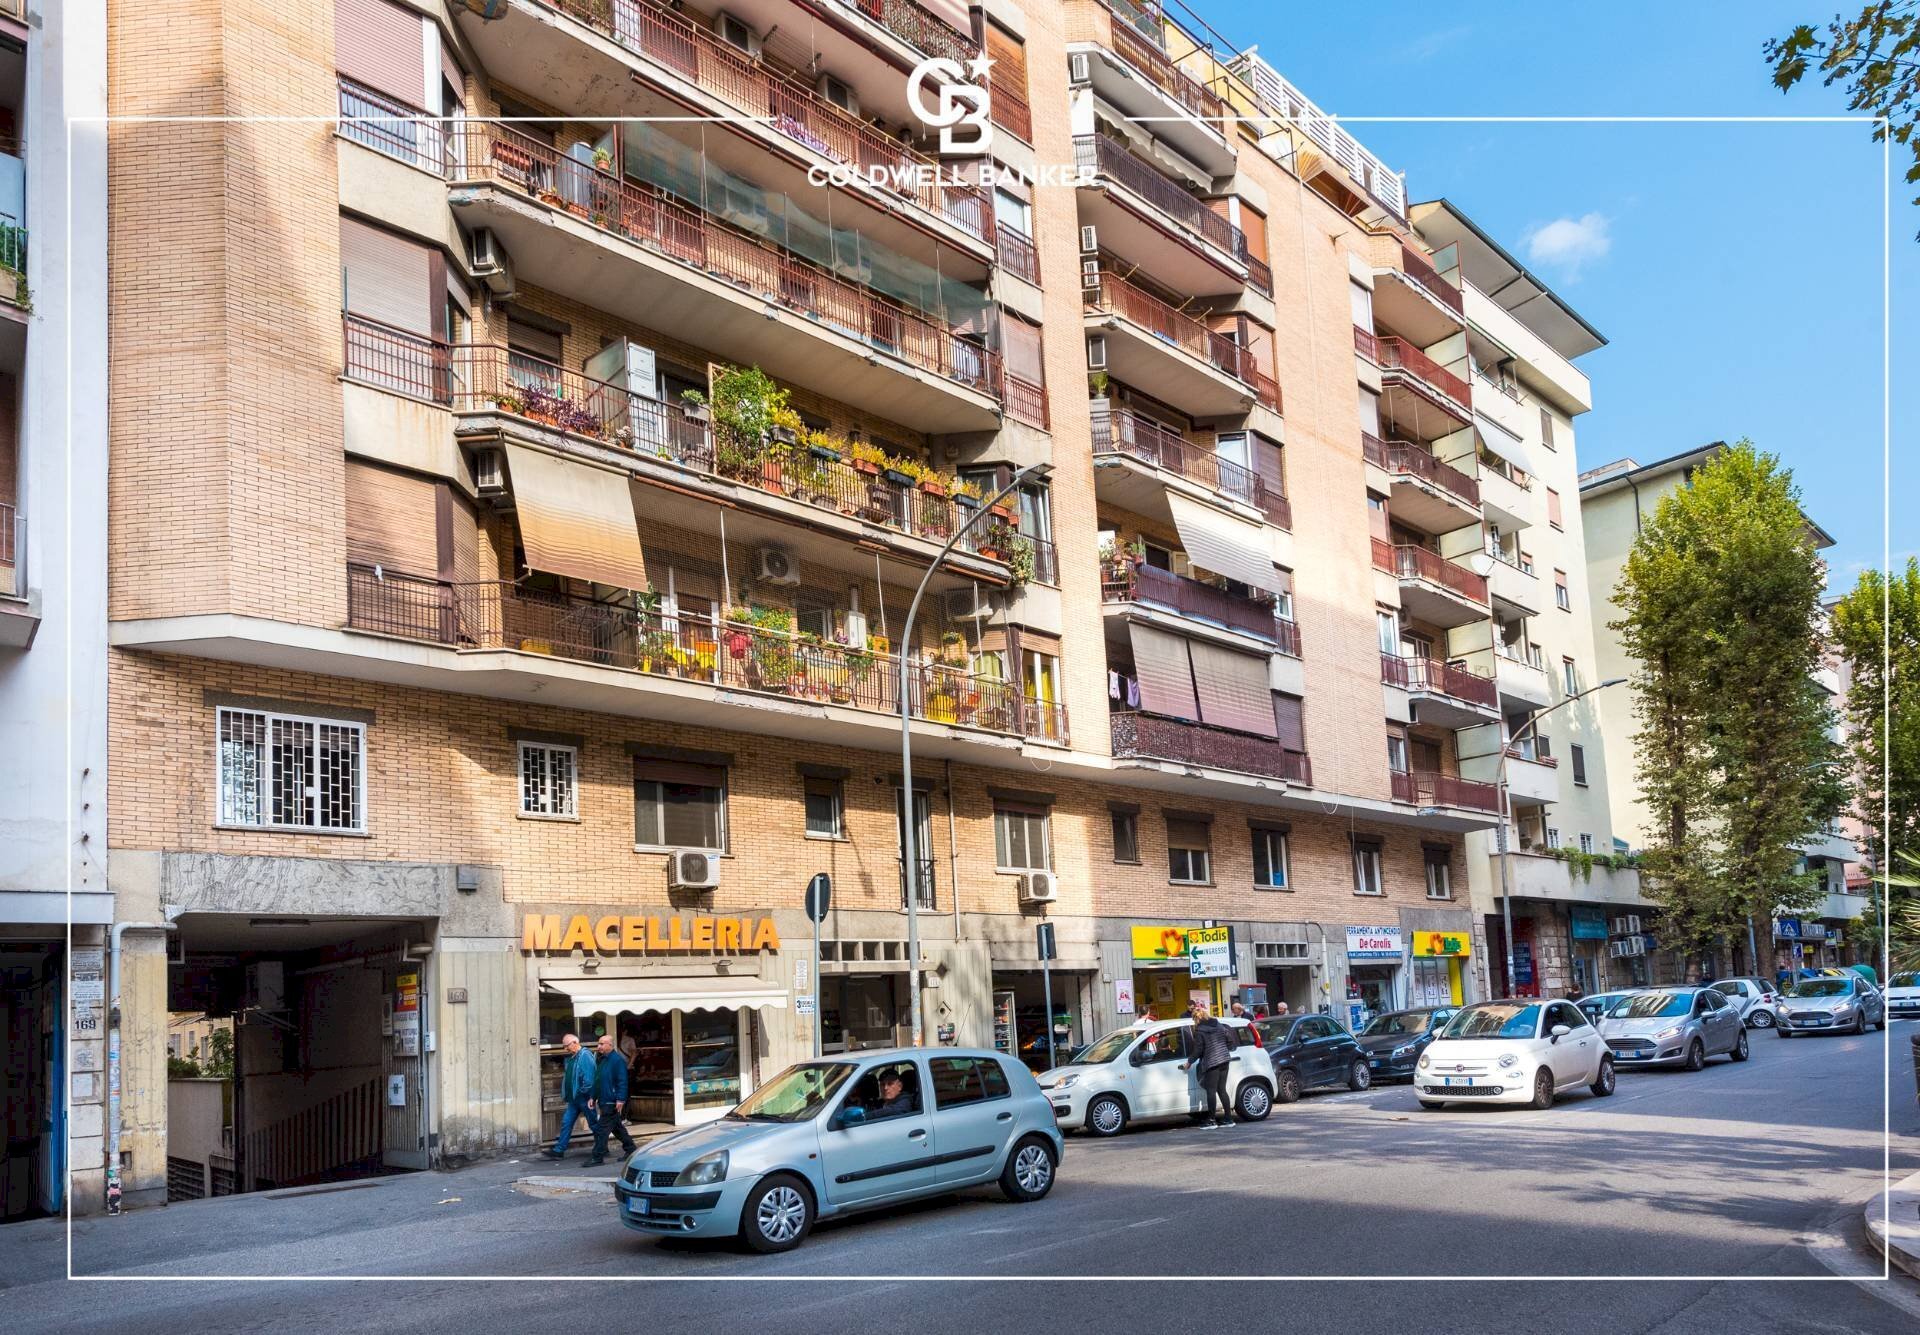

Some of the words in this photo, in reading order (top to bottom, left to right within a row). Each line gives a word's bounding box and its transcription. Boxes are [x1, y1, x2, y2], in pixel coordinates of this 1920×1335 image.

[520, 913, 781, 951] MACELLERIA
[1199, 930, 1227, 943] Todis
[1359, 938, 1368, 949] De
[1369, 938, 1392, 949] Carolis
[1203, 947, 1228, 955] INGRESSO
[75, 1019, 96, 1030] 169
